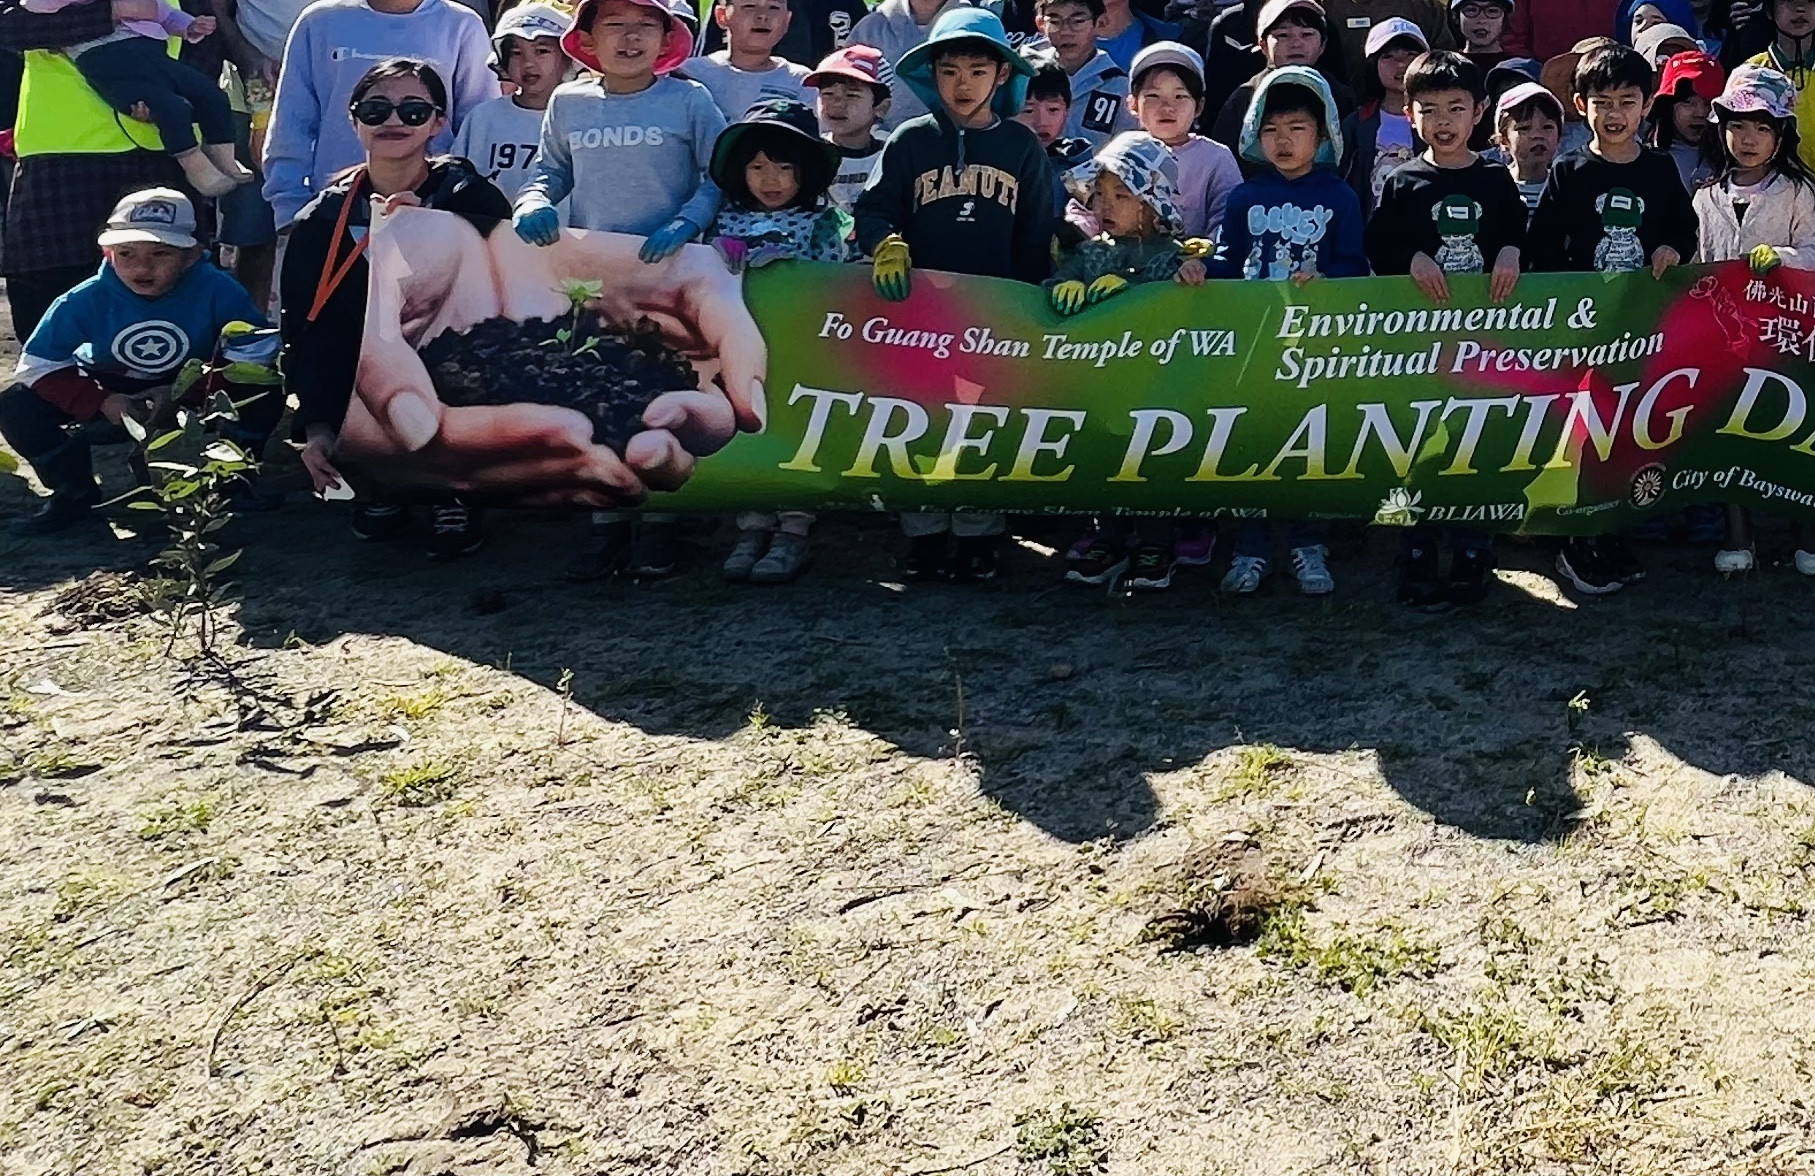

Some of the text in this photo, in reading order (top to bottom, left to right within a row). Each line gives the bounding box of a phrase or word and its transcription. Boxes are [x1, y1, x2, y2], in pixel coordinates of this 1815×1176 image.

[1094, 97, 1115, 124] 91
[569, 126, 664, 150] BONDS
[1276, 297, 1598, 339] Environmental &
[818, 312, 1237, 367] Fo Guang Shan Temple of WA
[1275, 330, 1664, 388] Spiritual Preservation
[778, 383, 1087, 481] TREE
[1106, 367, 1700, 482] PLANTING
[1672, 467, 1708, 491] City
[1712, 465, 1739, 488] of
[1231, 508, 1267, 517] WA
[1427, 502, 1526, 522] BLIAWA
